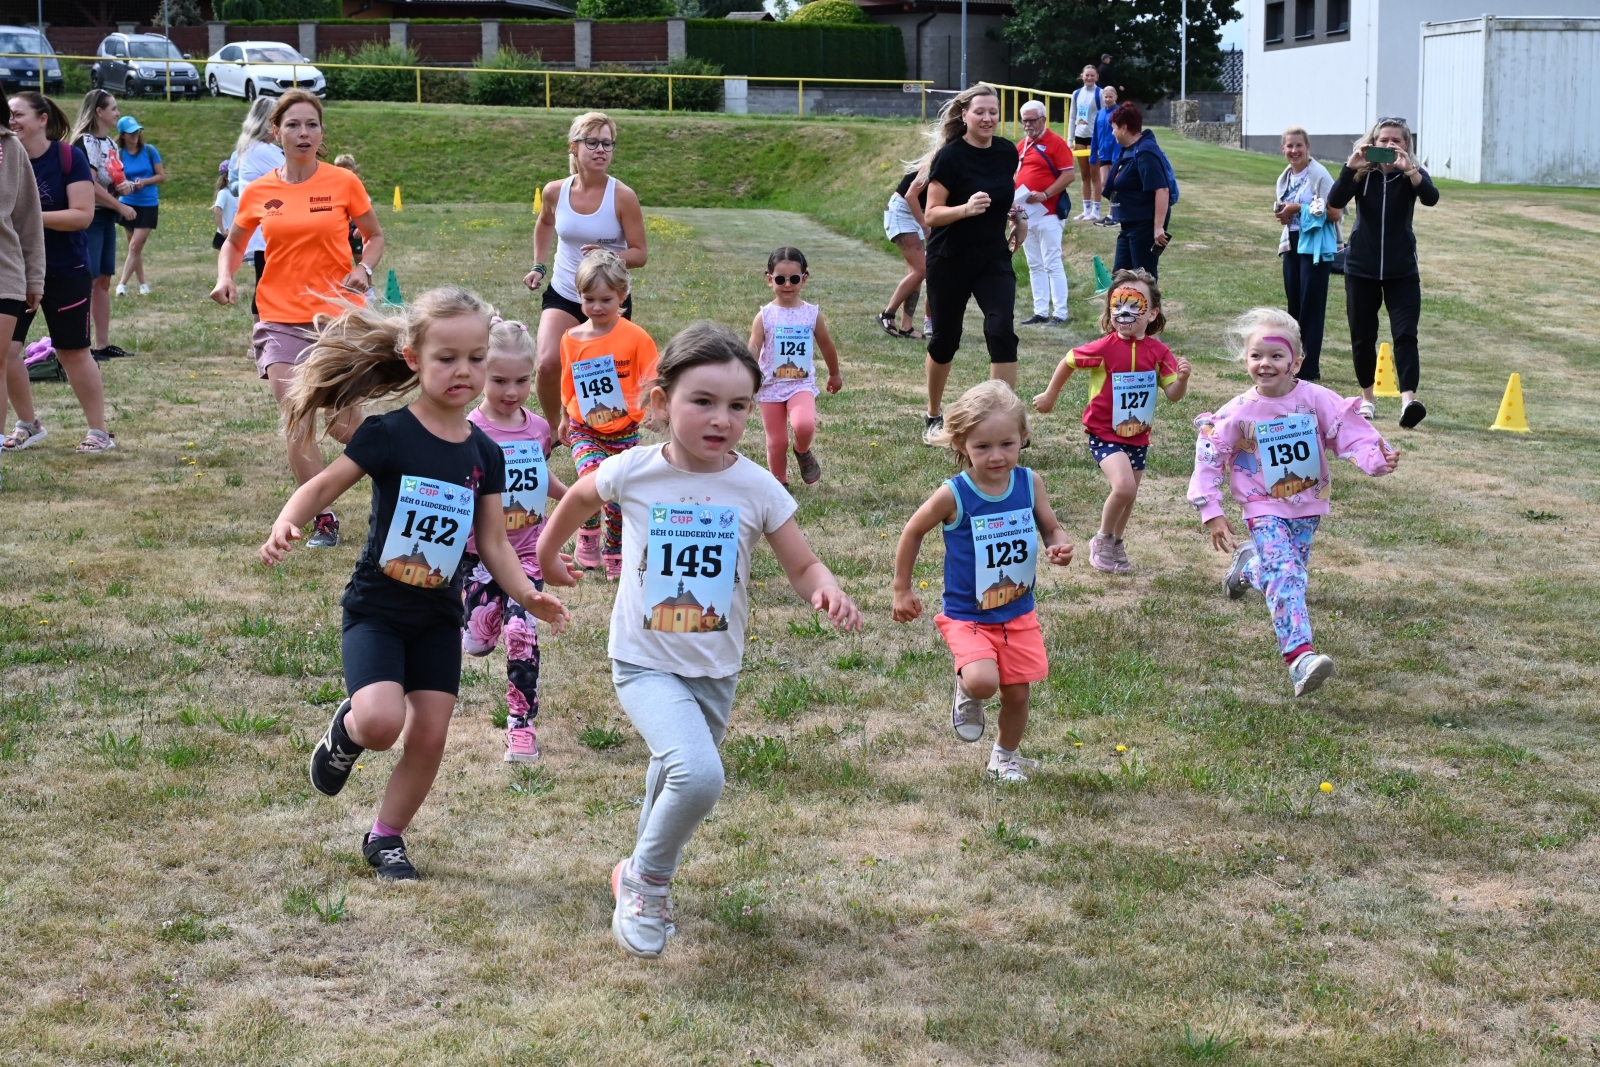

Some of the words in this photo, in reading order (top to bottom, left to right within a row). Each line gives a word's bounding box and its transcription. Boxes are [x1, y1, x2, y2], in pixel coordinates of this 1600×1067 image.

[780, 341, 806, 356] 124
[580, 376, 614, 398] 148
[1120, 391, 1149, 409] 127
[1268, 440, 1310, 466] 130
[505, 467, 538, 492] 25
[419, 488, 439, 497] CUP
[400, 496, 413, 504] BĚH
[421, 500, 456, 513] LUDGERŮV
[456, 507, 471, 516] MEČ
[401, 510, 458, 546] 142
[670, 516, 693, 524] CUP
[988, 521, 1004, 529] CUP
[650, 528, 666, 536] BĚH
[675, 530, 716, 538] LUDGERŮV
[661, 543, 722, 578] 145
[986, 539, 1028, 568] 123
